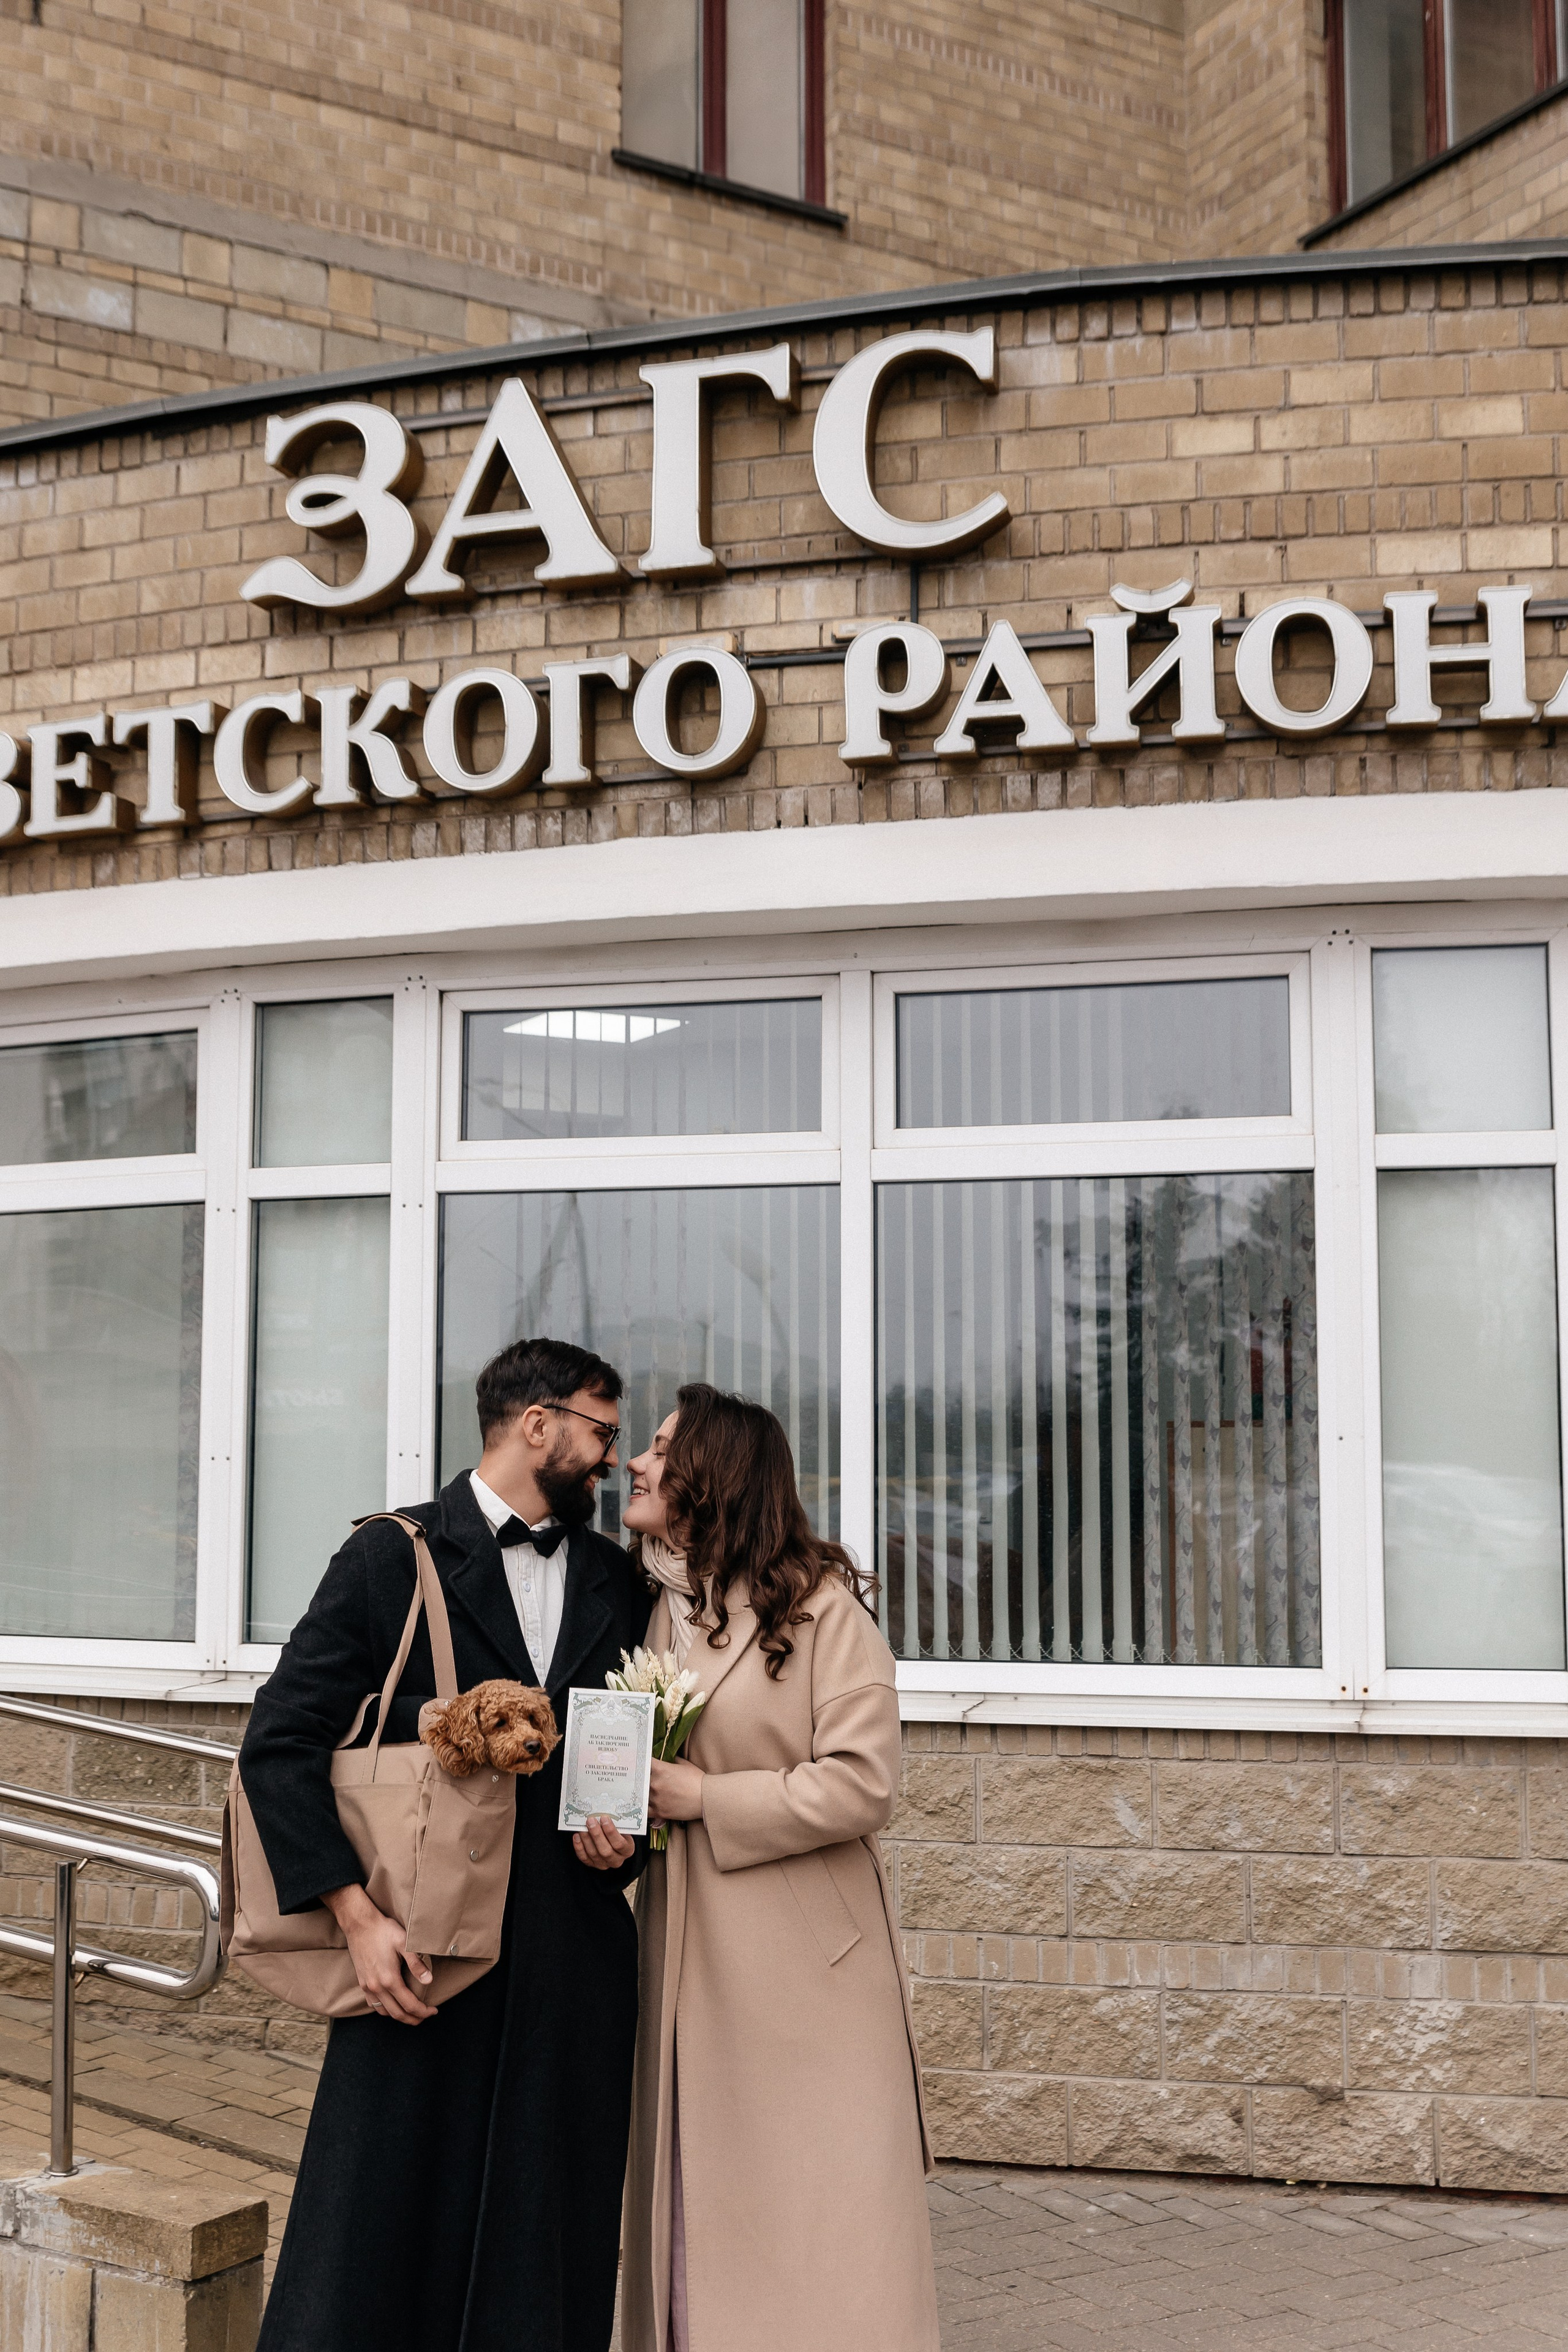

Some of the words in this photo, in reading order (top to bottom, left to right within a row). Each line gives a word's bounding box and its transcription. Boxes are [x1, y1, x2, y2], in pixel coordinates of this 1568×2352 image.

[241, 326, 1011, 610] ЗАГС
[0, 645, 757, 840] ЕТСКОГО
[840, 579, 1568, 767] РАЙОН
